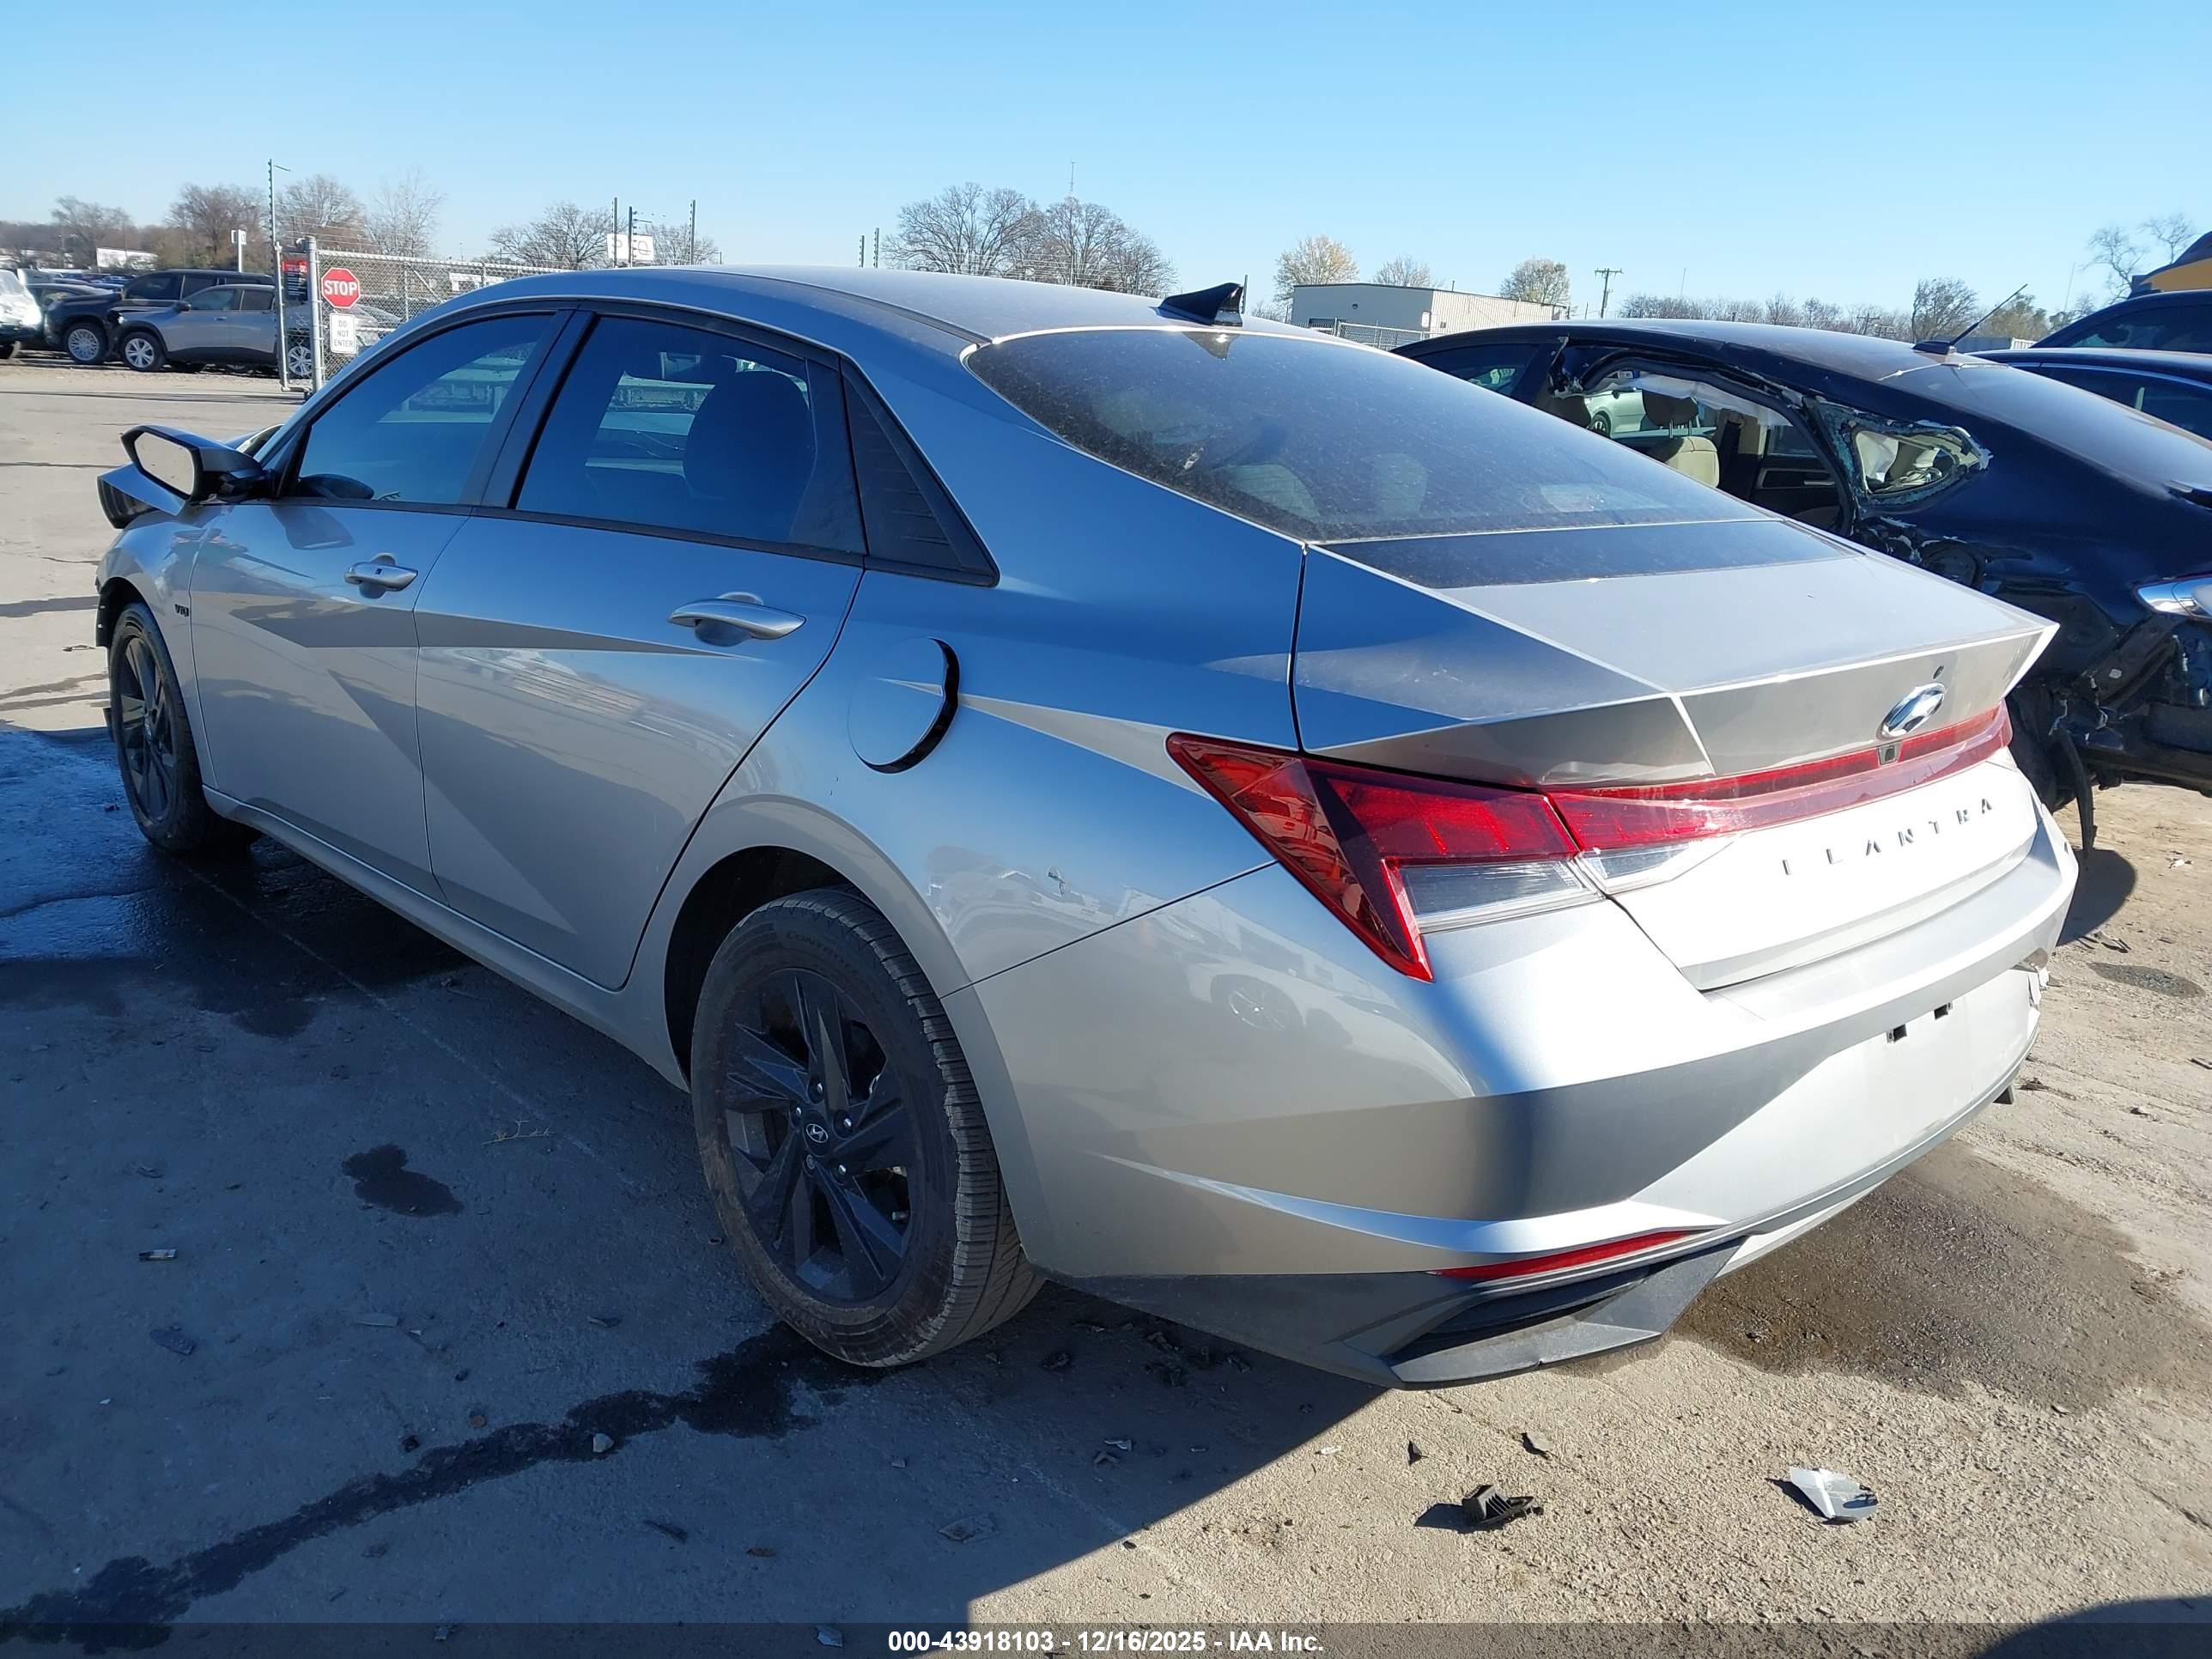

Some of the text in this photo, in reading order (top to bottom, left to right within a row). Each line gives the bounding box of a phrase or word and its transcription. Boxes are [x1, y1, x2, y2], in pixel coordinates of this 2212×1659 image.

[324, 279, 358, 296] STOP
[337, 319, 348, 328] DO
[337, 329, 349, 337] NOT
[333, 339, 353, 348] ENTER
